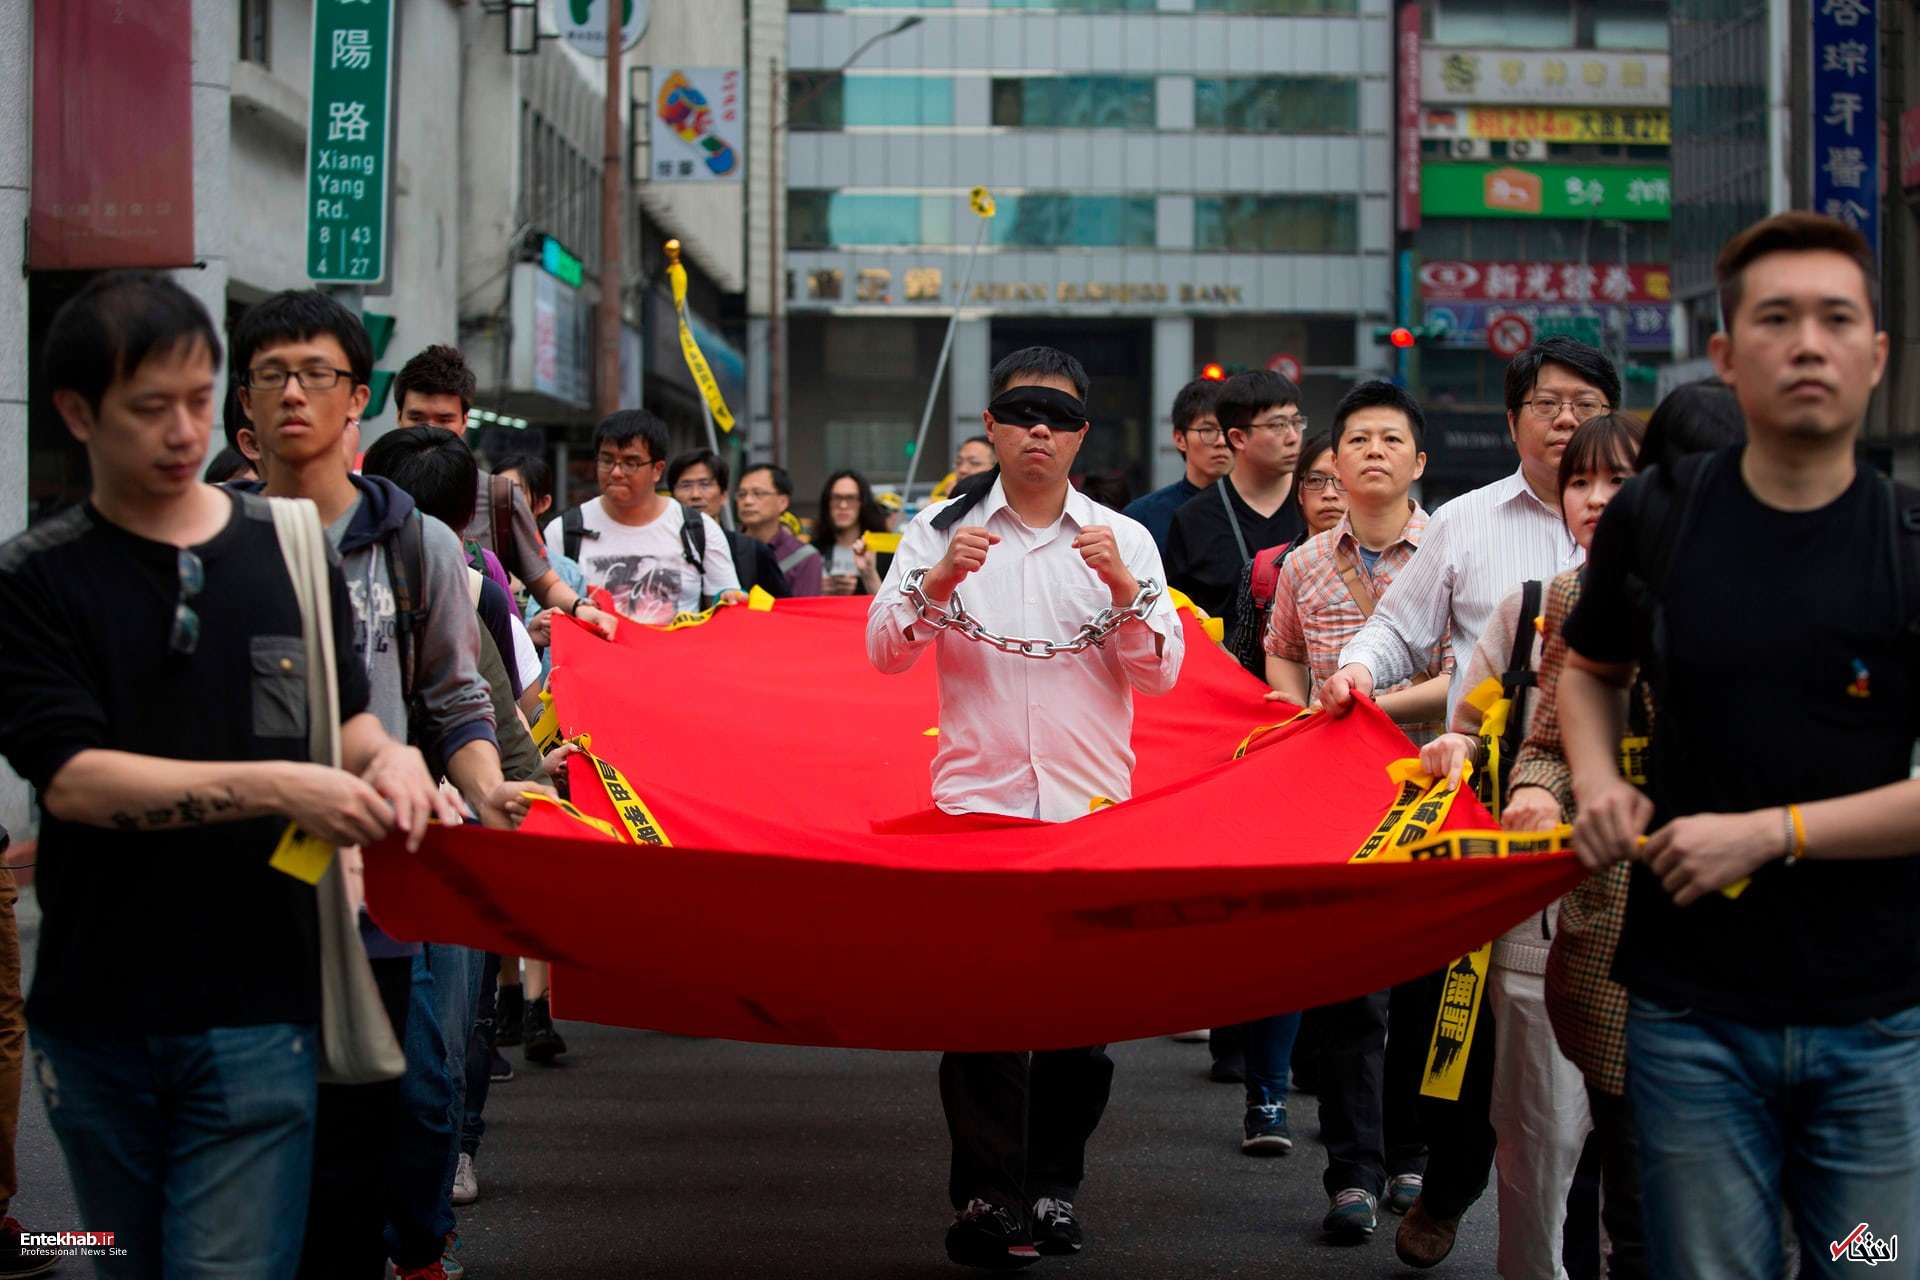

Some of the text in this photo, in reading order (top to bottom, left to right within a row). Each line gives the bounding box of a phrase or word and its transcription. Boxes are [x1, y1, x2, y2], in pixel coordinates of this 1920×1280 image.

[328, 0, 373, 142] 陽路
[318, 149, 375, 175] Xiang
[317, 174, 365, 199] Yang
[316, 199, 349, 219] Rd.
[319, 225, 371, 244] 8 43
[316, 257, 370, 275] 4 27
